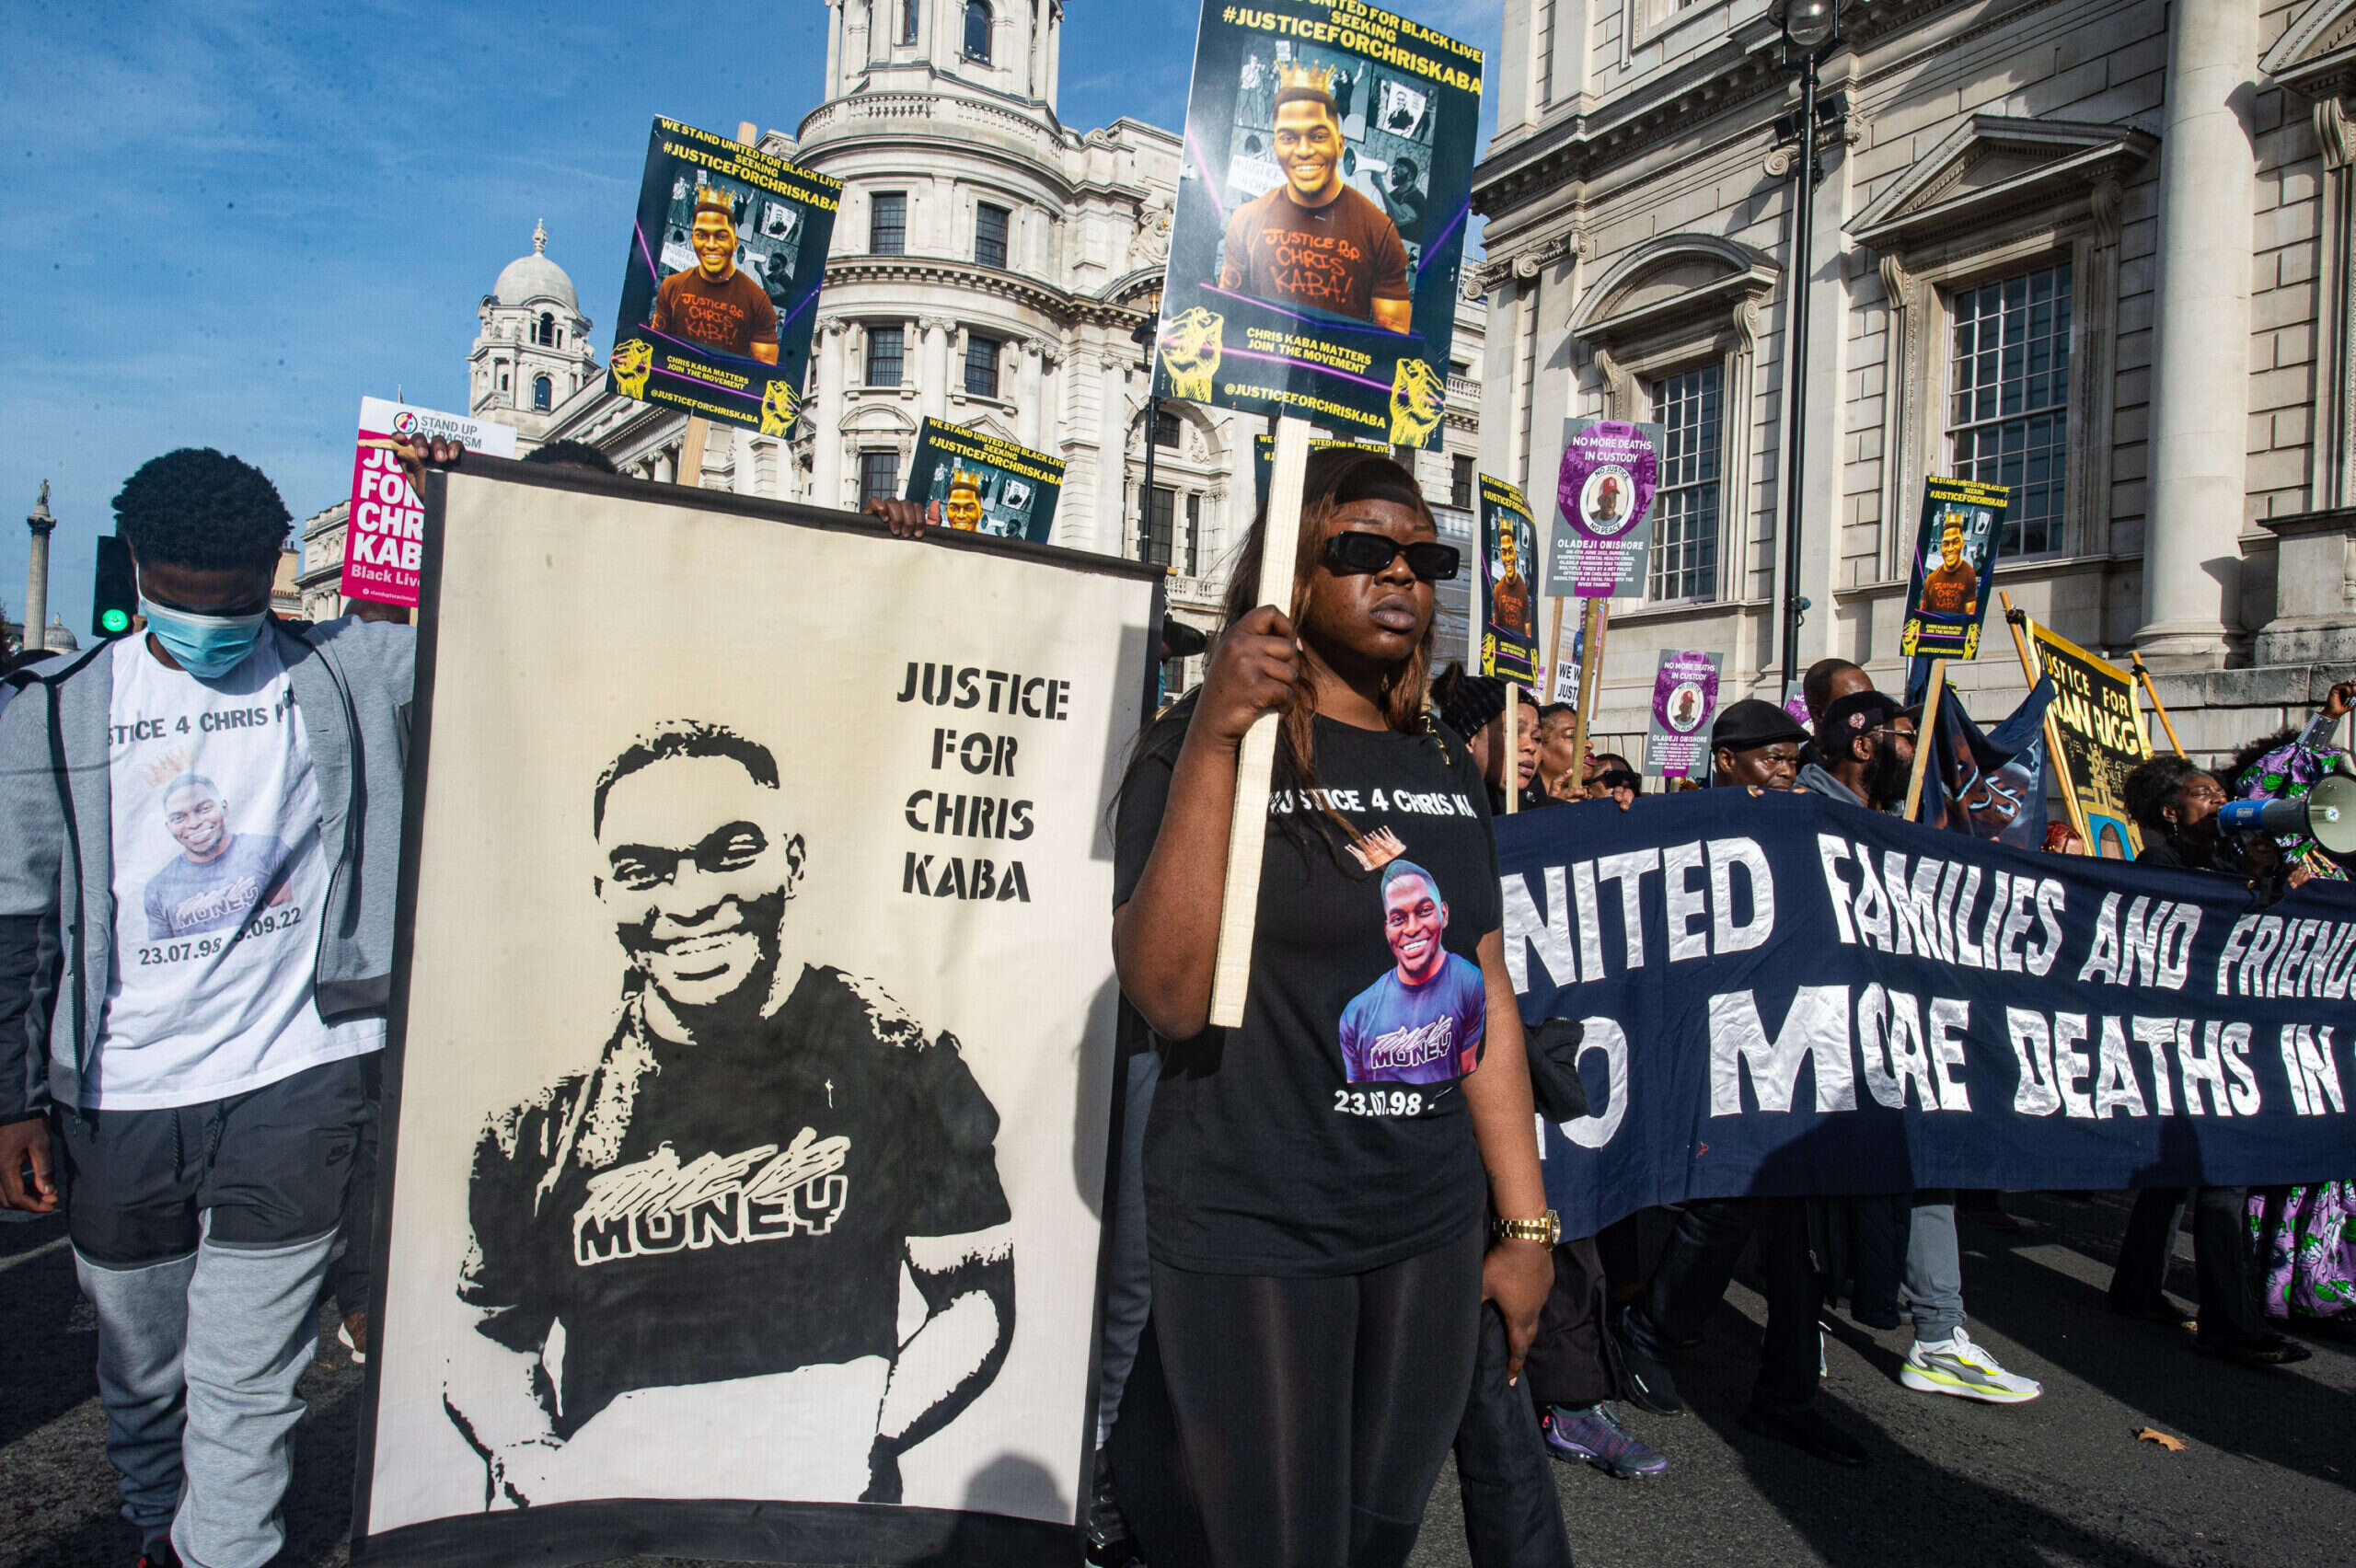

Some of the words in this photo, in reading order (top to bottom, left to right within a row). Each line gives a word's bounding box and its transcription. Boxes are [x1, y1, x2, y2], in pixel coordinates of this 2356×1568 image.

[1331, 10, 1397, 43] SEEKING
[1369, 6, 1400, 29] FOR
[1401, 18, 1449, 50] BLACK
[1451, 40, 1484, 63] LIVE
[1222, 6, 1482, 96] #JUSTICEFORCHRISKABA
[662, 118, 680, 133] WE
[681, 125, 720, 145] STAND
[721, 138, 759, 159] UNITED
[760, 154, 782, 168] FOR
[782, 161, 817, 182] BLACK
[818, 174, 843, 190] LIVE
[735, 154, 779, 178] SEEKING
[663, 140, 838, 213] #JUSTICEFORCHRISKABA
[1262, 227, 1335, 249] JUSTICE
[1276, 246, 1345, 276] CHRIS
[1270, 265, 1354, 304] KABA!
[688, 306, 733, 329] CHRIS
[1246, 327, 1283, 342] CHRIS
[1284, 334, 1318, 351] KABA
[1319, 341, 1371, 365] MATTERS
[1247, 339, 1275, 353] JOIN
[1278, 343, 1302, 358] THE
[1303, 349, 1367, 375] MOVEMENT
[666, 355, 690, 369] CHRIS
[691, 361, 712, 375] KABA
[712, 368, 749, 385] MATTERS
[667, 363, 685, 374] JOIN
[687, 367, 701, 379] THE
[702, 373, 745, 390] MOVEMENT
[650, 388, 759, 424] @JUSTICEFORCHRISKABA
[1224, 383, 1386, 430] @JUSTICEFORCHRISKABA
[421, 416, 458, 432] STAND
[461, 424, 478, 435] UP
[929, 418, 943, 429] WE
[943, 422, 973, 438] STAND
[974, 432, 1004, 448] UNITED
[1004, 442, 1022, 454] FOR
[1021, 447, 1047, 463] BLACK
[1047, 456, 1067, 469] LIVE
[1572, 436, 1588, 446] NO
[1589, 437, 1618, 448] MORE
[1618, 440, 1652, 450] DEATHS
[929, 435, 1063, 486] #JUSTICEFORCHRISKABA
[983, 444, 1018, 461] SEEKING
[1259, 435, 1273, 444] WE
[1373, 444, 1390, 454] LIVE
[1585, 451, 1596, 461] IN
[1597, 452, 1639, 463] CUSTODY
[1595, 467, 1605, 478] NO
[357, 502, 424, 541] CHR
[1589, 522, 1600, 532] NO
[352, 532, 422, 571] KAB
[1557, 538, 1598, 549] OLADEJI
[351, 563, 392, 583] Black
[396, 571, 421, 587] Liv
[1559, 663, 1572, 679] WE
[1664, 662, 1674, 670] NO
[896, 662, 1070, 721] JUSTICE
[1558, 684, 1578, 701] JUST
[2102, 686, 2131, 718] FOR
[108, 718, 167, 746] TICE
[176, 716, 191, 734] 4
[199, 708, 269, 732] CHRIS
[2093, 705, 2140, 755] RIGG
[930, 728, 1018, 778] FOR
[905, 789, 1034, 841] CHRIS
[1371, 788, 1390, 812] 4
[1392, 789, 1456, 816] CHRIS
[1451, 794, 1478, 819] KA
[902, 851, 1032, 903] KABA
[175, 885, 260, 929] MONEY
[1499, 836, 1775, 995] NITED
[1818, 833, 2065, 978] FAMILIES
[2077, 892, 2203, 990] AND
[2216, 913, 2356, 1000] FRIEND
[138, 937, 223, 966] 23.07.98
[1370, 1032, 1452, 1069] MONEY
[1535, 1016, 1628, 1160] O
[2006, 1006, 2261, 1120] DEATHS
[2280, 1022, 2346, 1116] IN
[572, 1174, 849, 1267] MONEY
